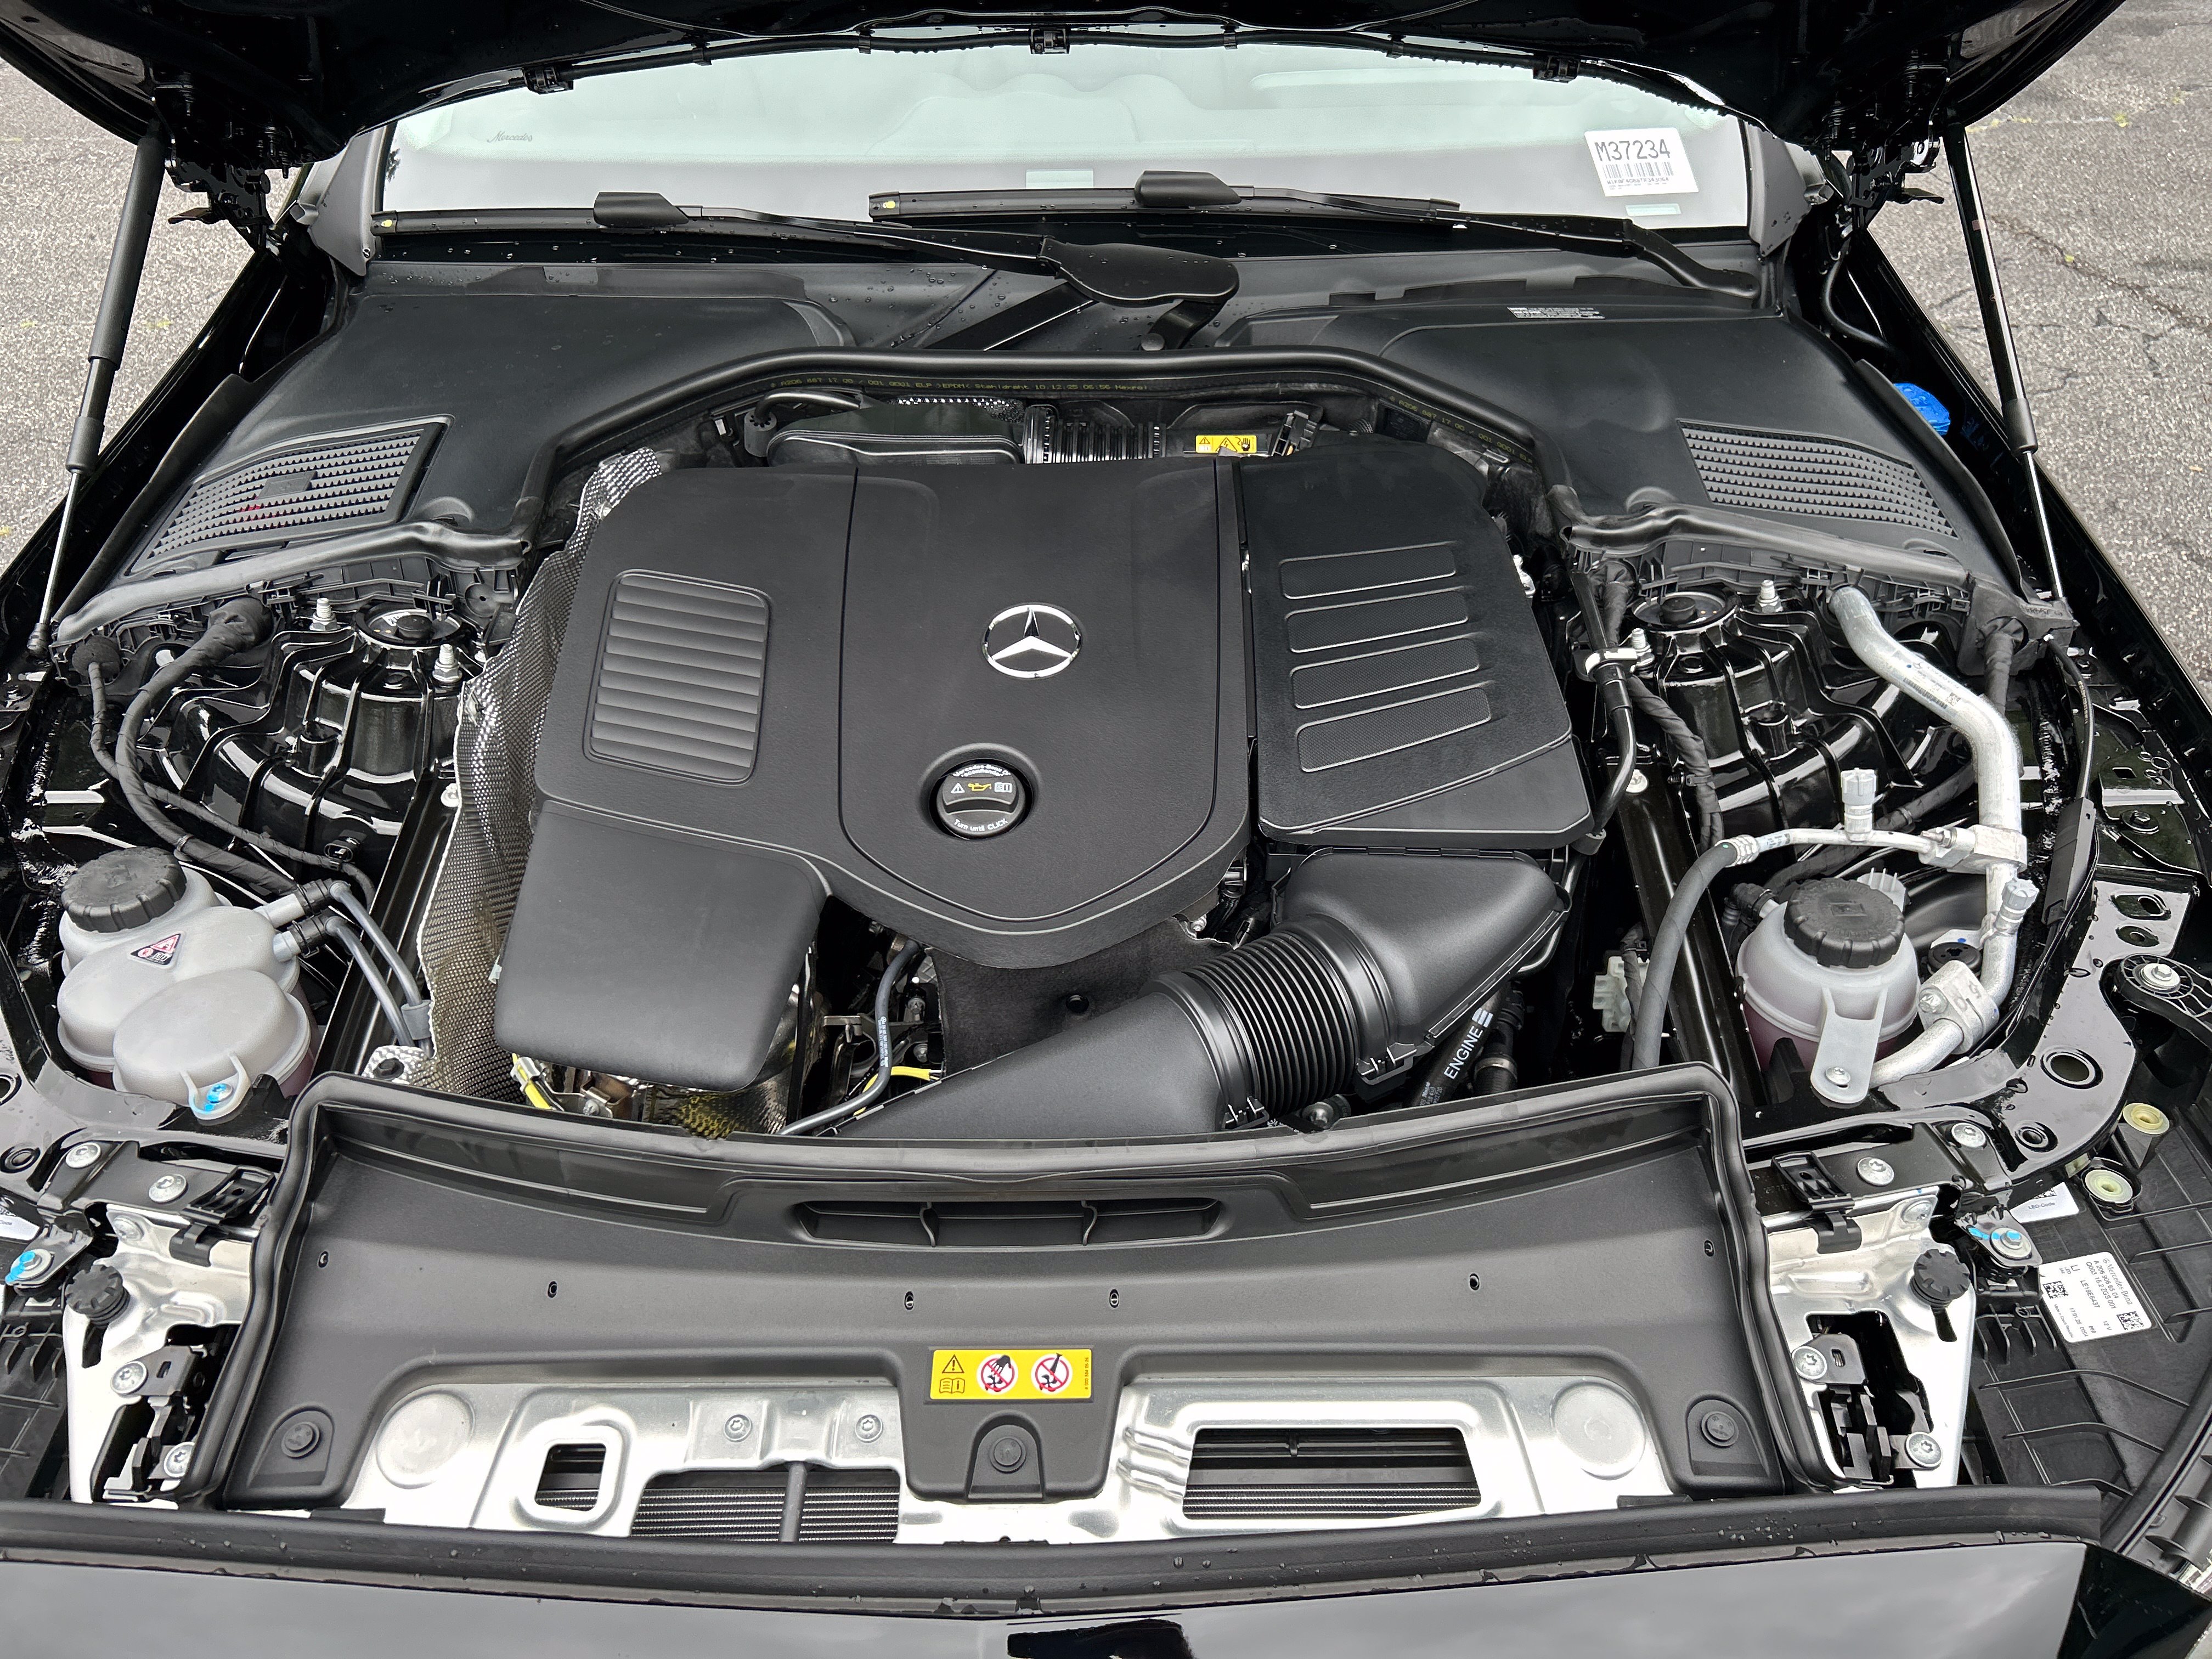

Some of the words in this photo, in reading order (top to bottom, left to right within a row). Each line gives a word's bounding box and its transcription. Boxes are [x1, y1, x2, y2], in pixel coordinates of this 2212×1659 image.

[487, 131, 533, 143] Mercedes
[1594, 139, 1671, 161] M37234
[954, 819, 968, 830] Turn
[987, 818, 1008, 830] CLICK
[1443, 1025, 1483, 1080] ENGINE
[2107, 1265, 2132, 1305] Mercedes-Benz
